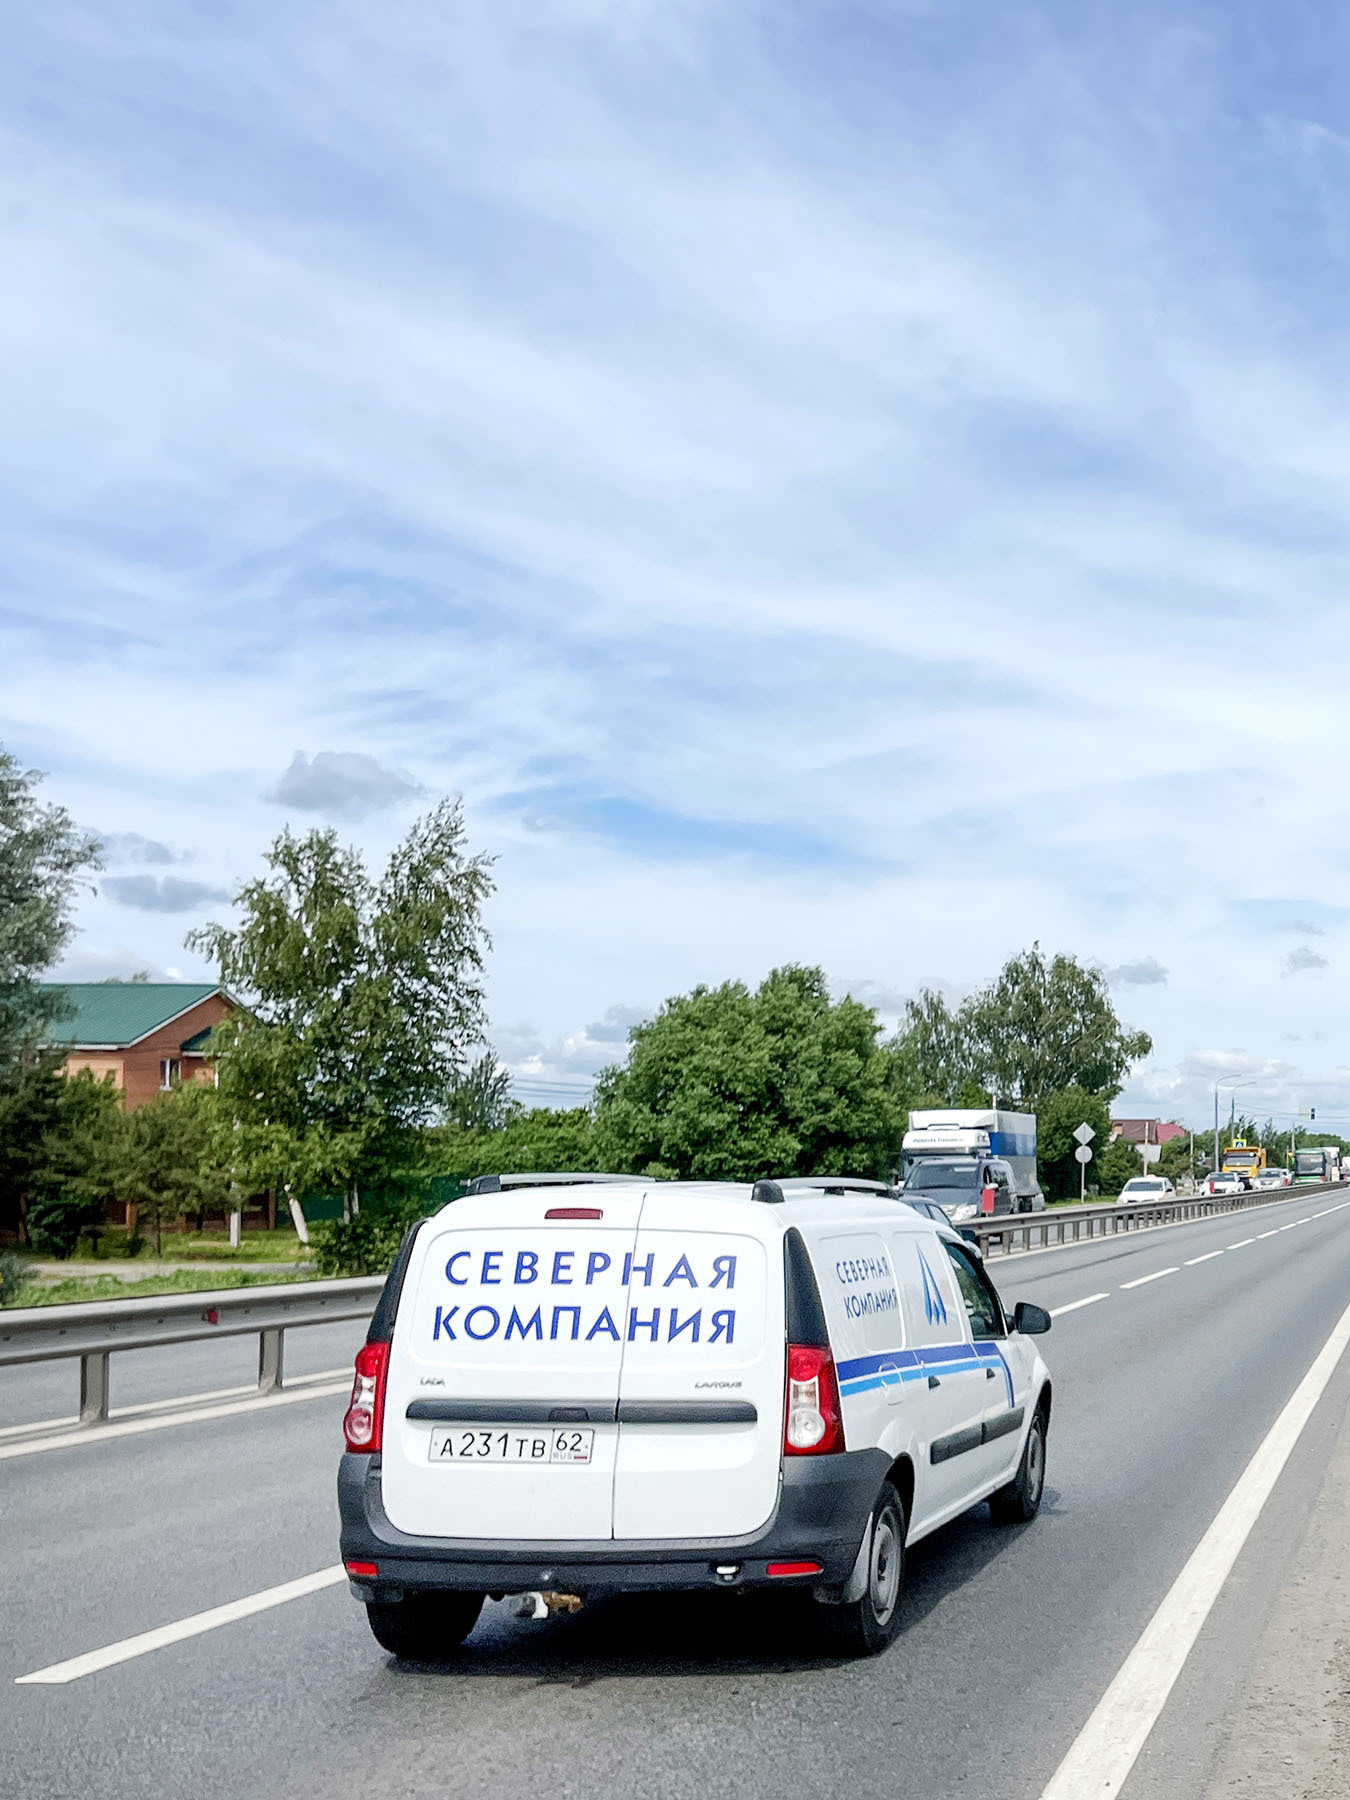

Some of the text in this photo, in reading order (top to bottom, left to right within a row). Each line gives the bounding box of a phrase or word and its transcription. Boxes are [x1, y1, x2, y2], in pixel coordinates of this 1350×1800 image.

[445, 1251, 738, 1289] СЕВЕРНАЯ
[836, 1257, 891, 1284] СЕВЕРНАЯ
[844, 1288, 898, 1319] КОМПАНИЯ
[433, 1305, 736, 1344] КОМПАНИЯ
